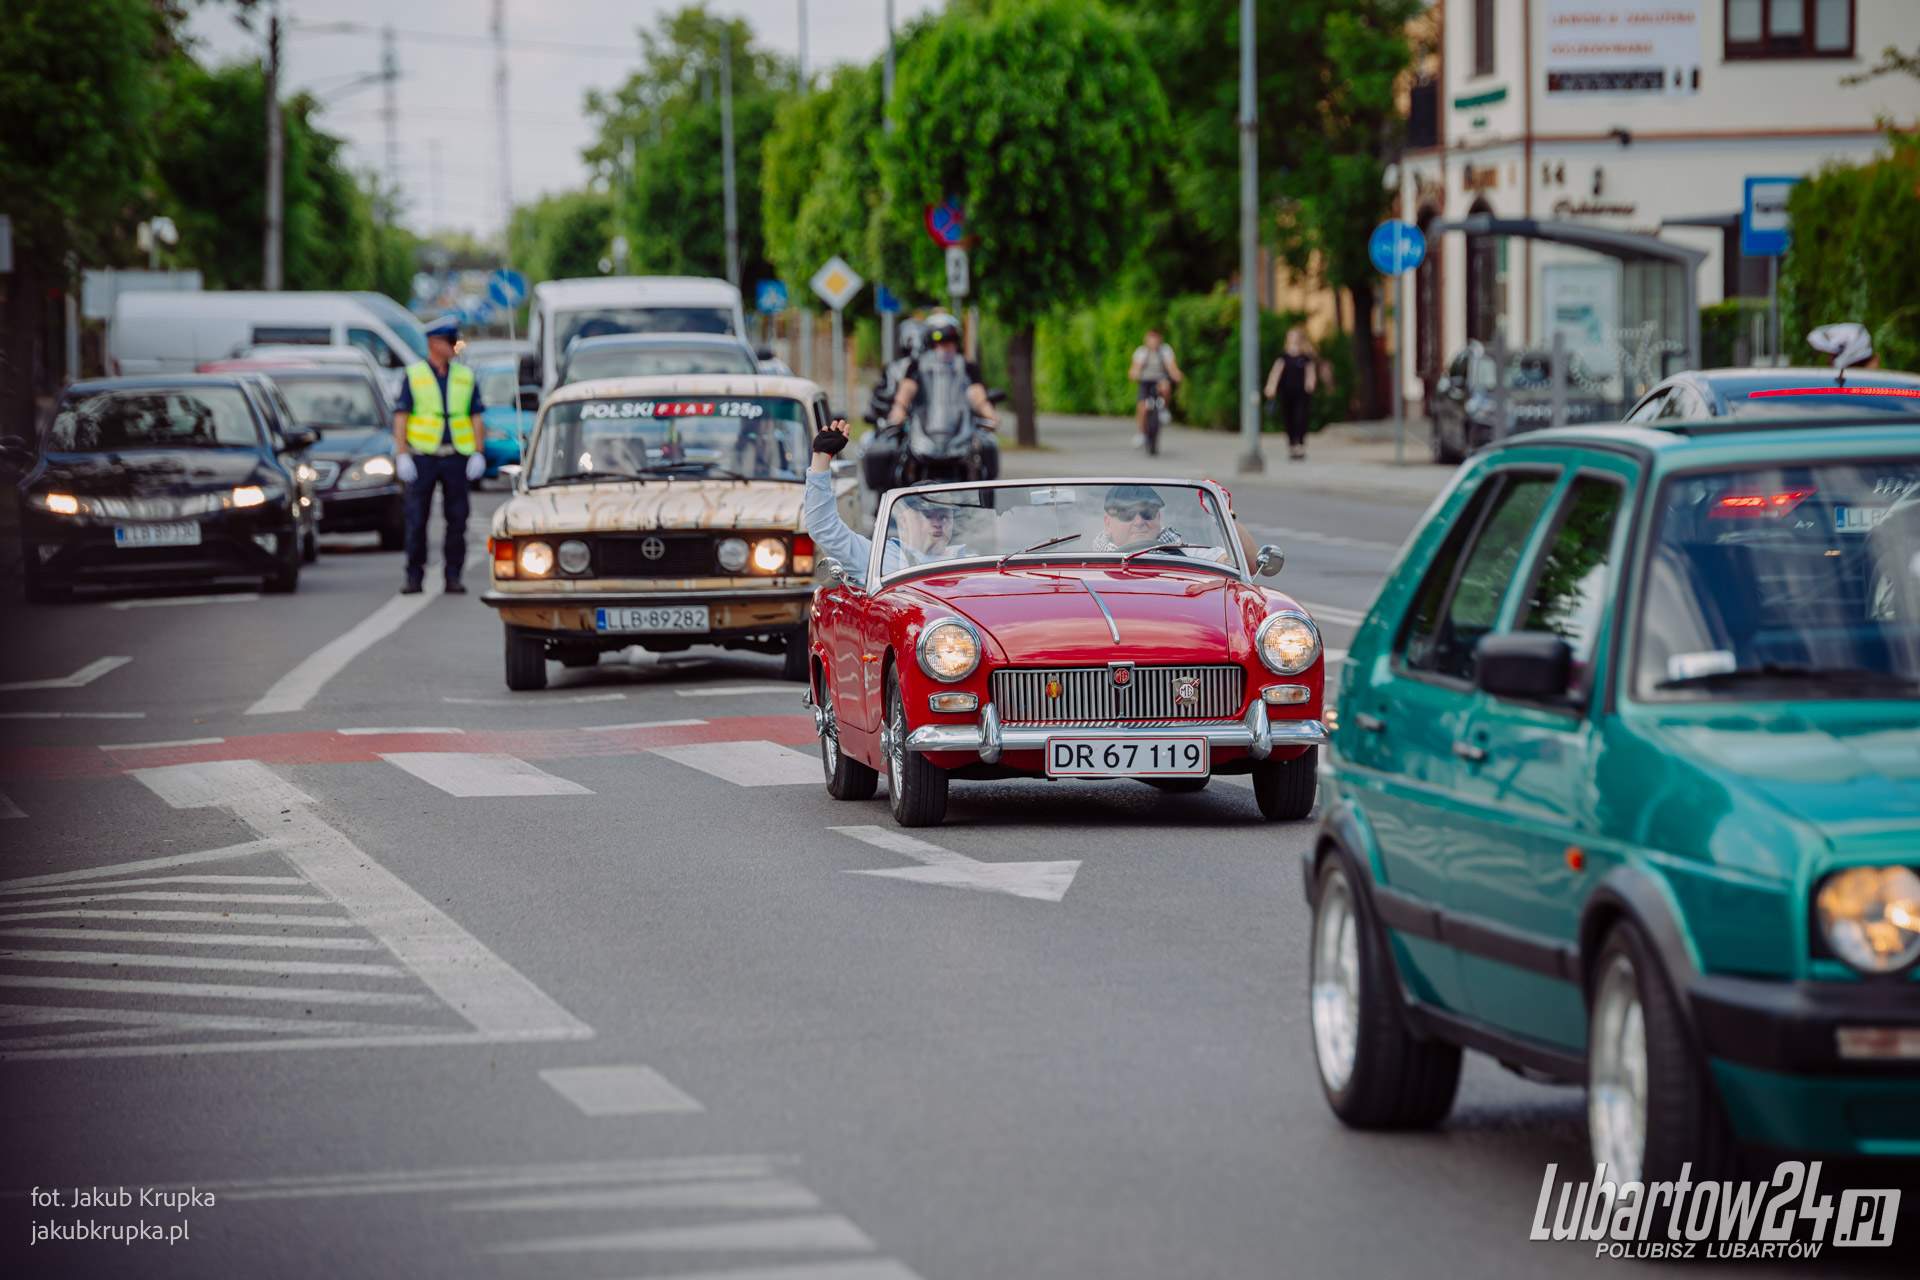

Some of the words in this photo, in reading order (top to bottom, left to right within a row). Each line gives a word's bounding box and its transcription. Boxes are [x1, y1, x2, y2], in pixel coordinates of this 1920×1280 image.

[580, 402, 654, 420] POLSKI
[657, 404, 714, 416] FIAT
[719, 402, 763, 419] 125p
[608, 610, 643, 629] LLB
[648, 609, 706, 628] 89282
[1113, 668, 1130, 684] MG
[1179, 684, 1194, 699] MG
[1054, 744, 1095, 768] DR
[1103, 743, 1139, 768] 67
[1150, 743, 1200, 768] 119
